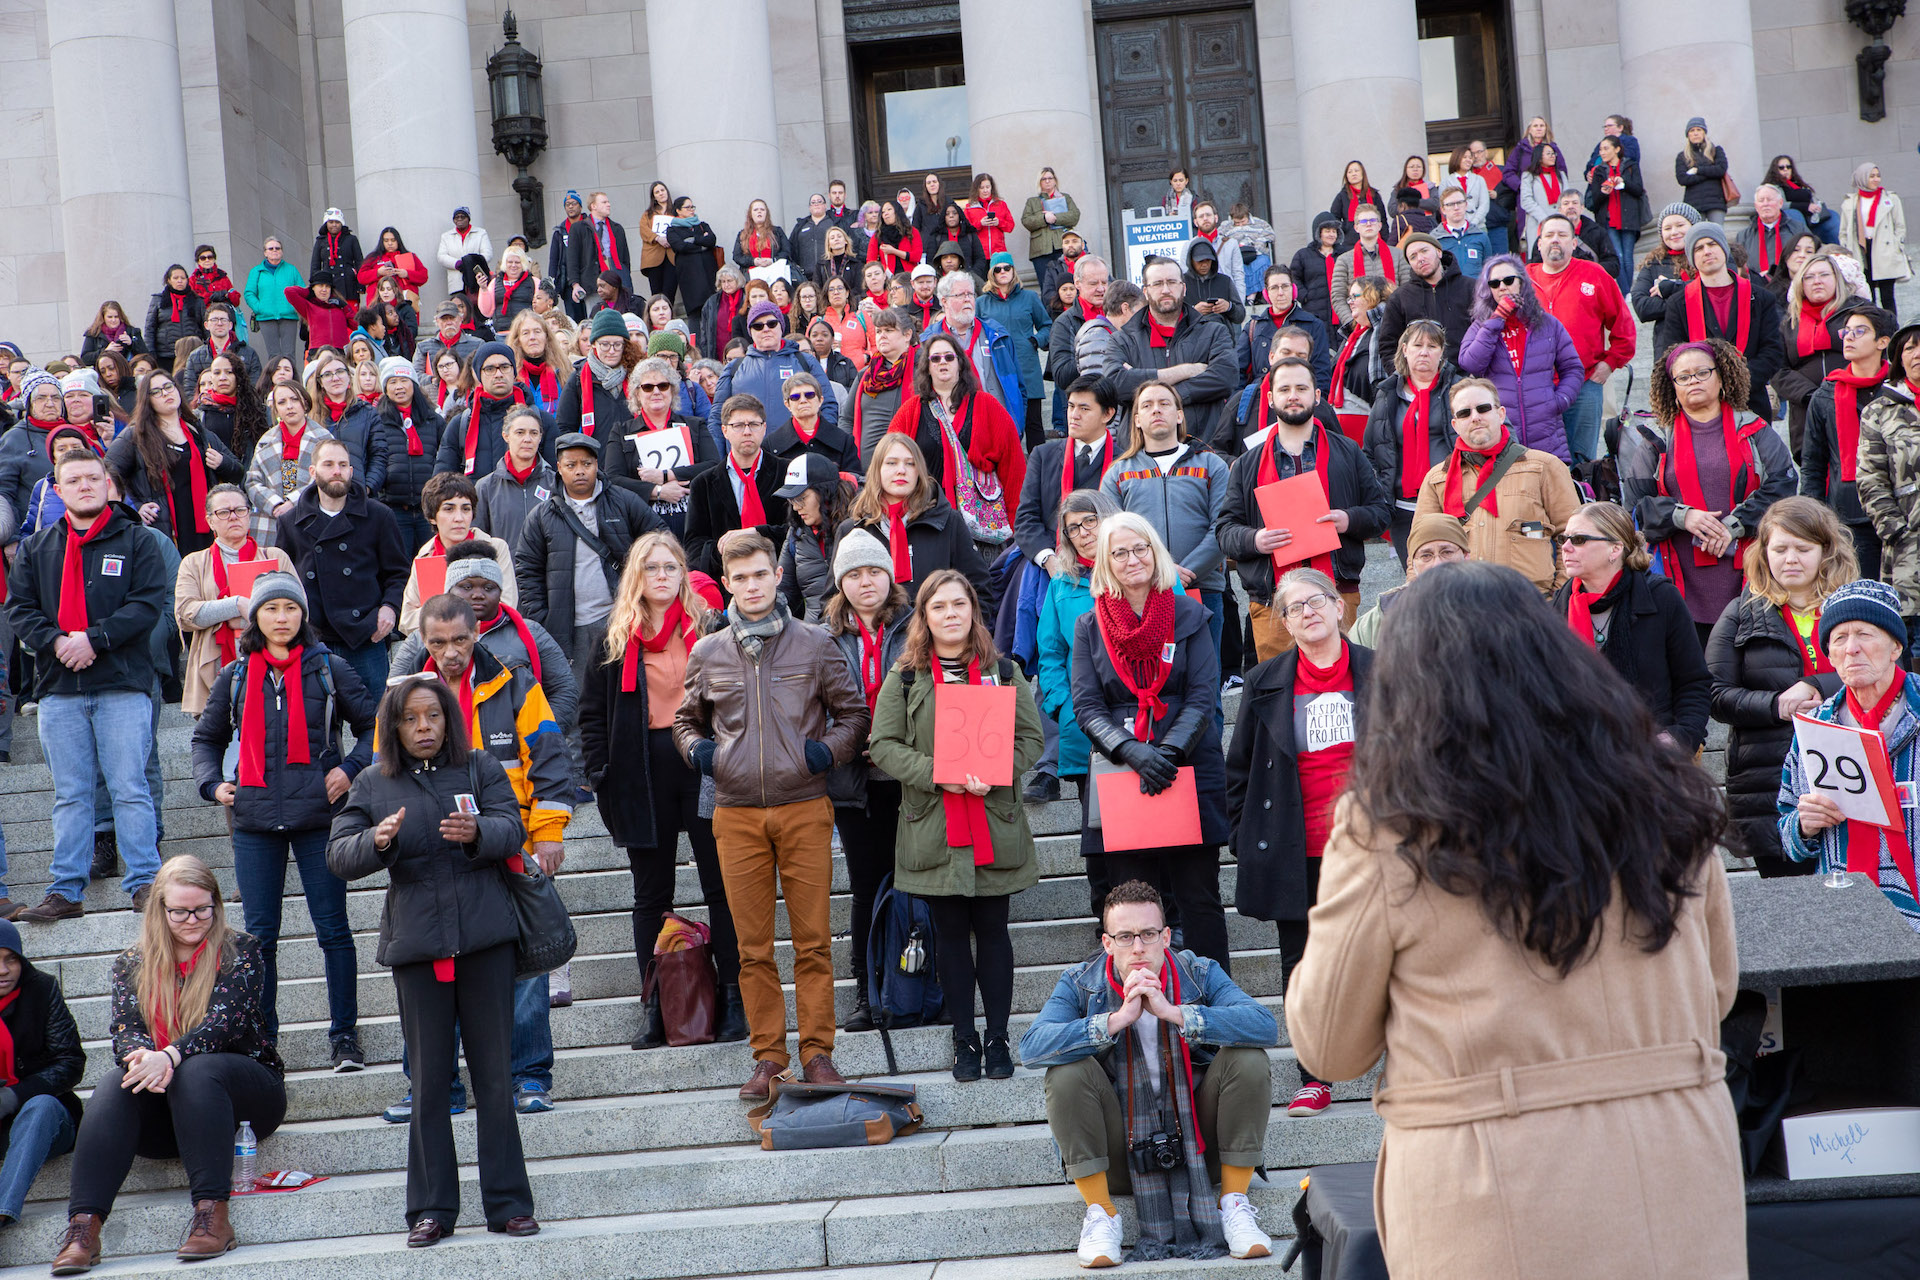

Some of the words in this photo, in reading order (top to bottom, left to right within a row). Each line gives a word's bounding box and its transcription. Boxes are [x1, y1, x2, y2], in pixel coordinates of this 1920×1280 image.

[1132, 226, 1141, 234] IN
[1143, 222, 1183, 233] ICY/COLD
[1137, 232, 1179, 242] WEATHER
[647, 445, 681, 469] 22
[1308, 703, 1350, 715] RESIDENT
[1310, 713, 1349, 728] ACTION
[944, 706, 1003, 762] 36
[1310, 727, 1351, 743] PROJECT
[1806, 749, 1867, 794] 29
